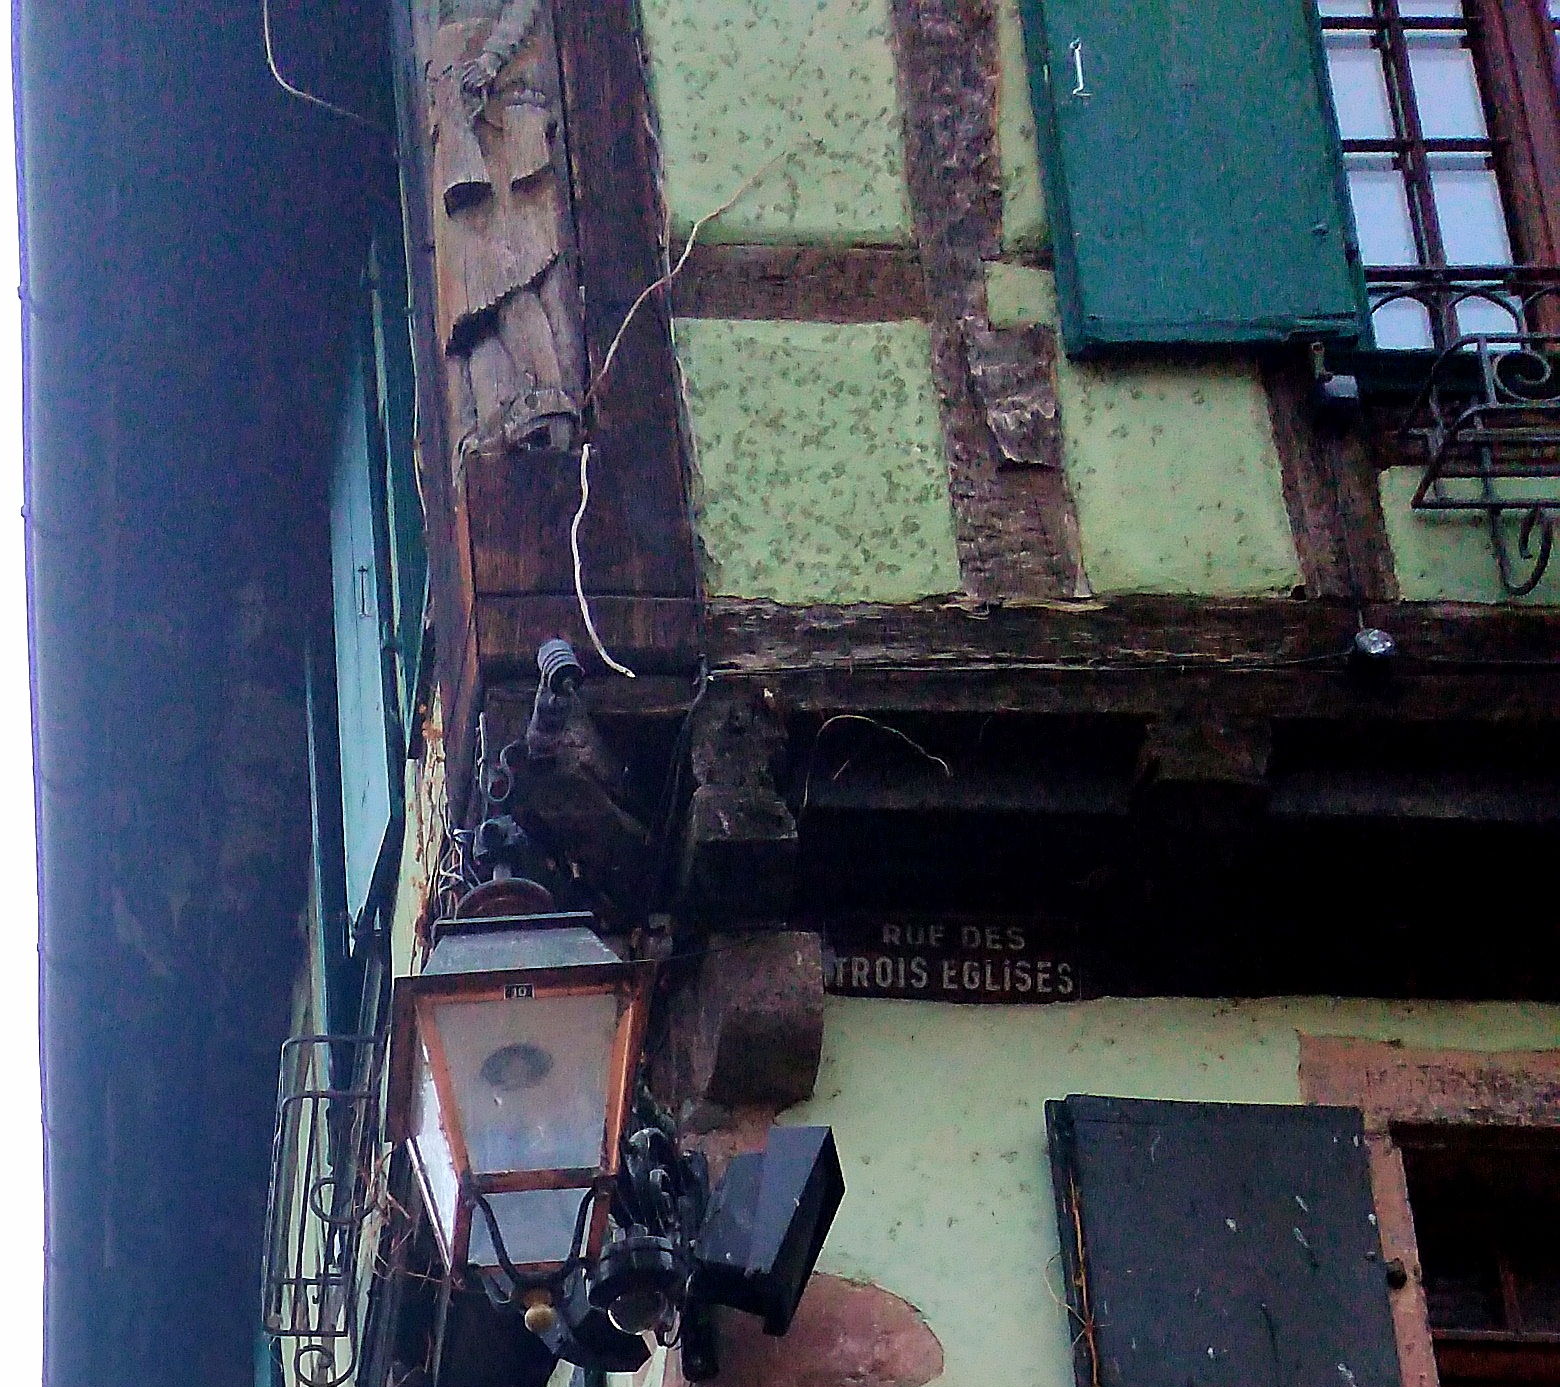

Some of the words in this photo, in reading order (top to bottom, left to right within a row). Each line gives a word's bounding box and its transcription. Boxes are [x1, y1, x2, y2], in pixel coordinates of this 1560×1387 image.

[882, 924, 944, 946] RUE
[961, 926, 1025, 950] DES
[833, 956, 928, 989] TROIS
[942, 958, 1073, 994] EGLISES
